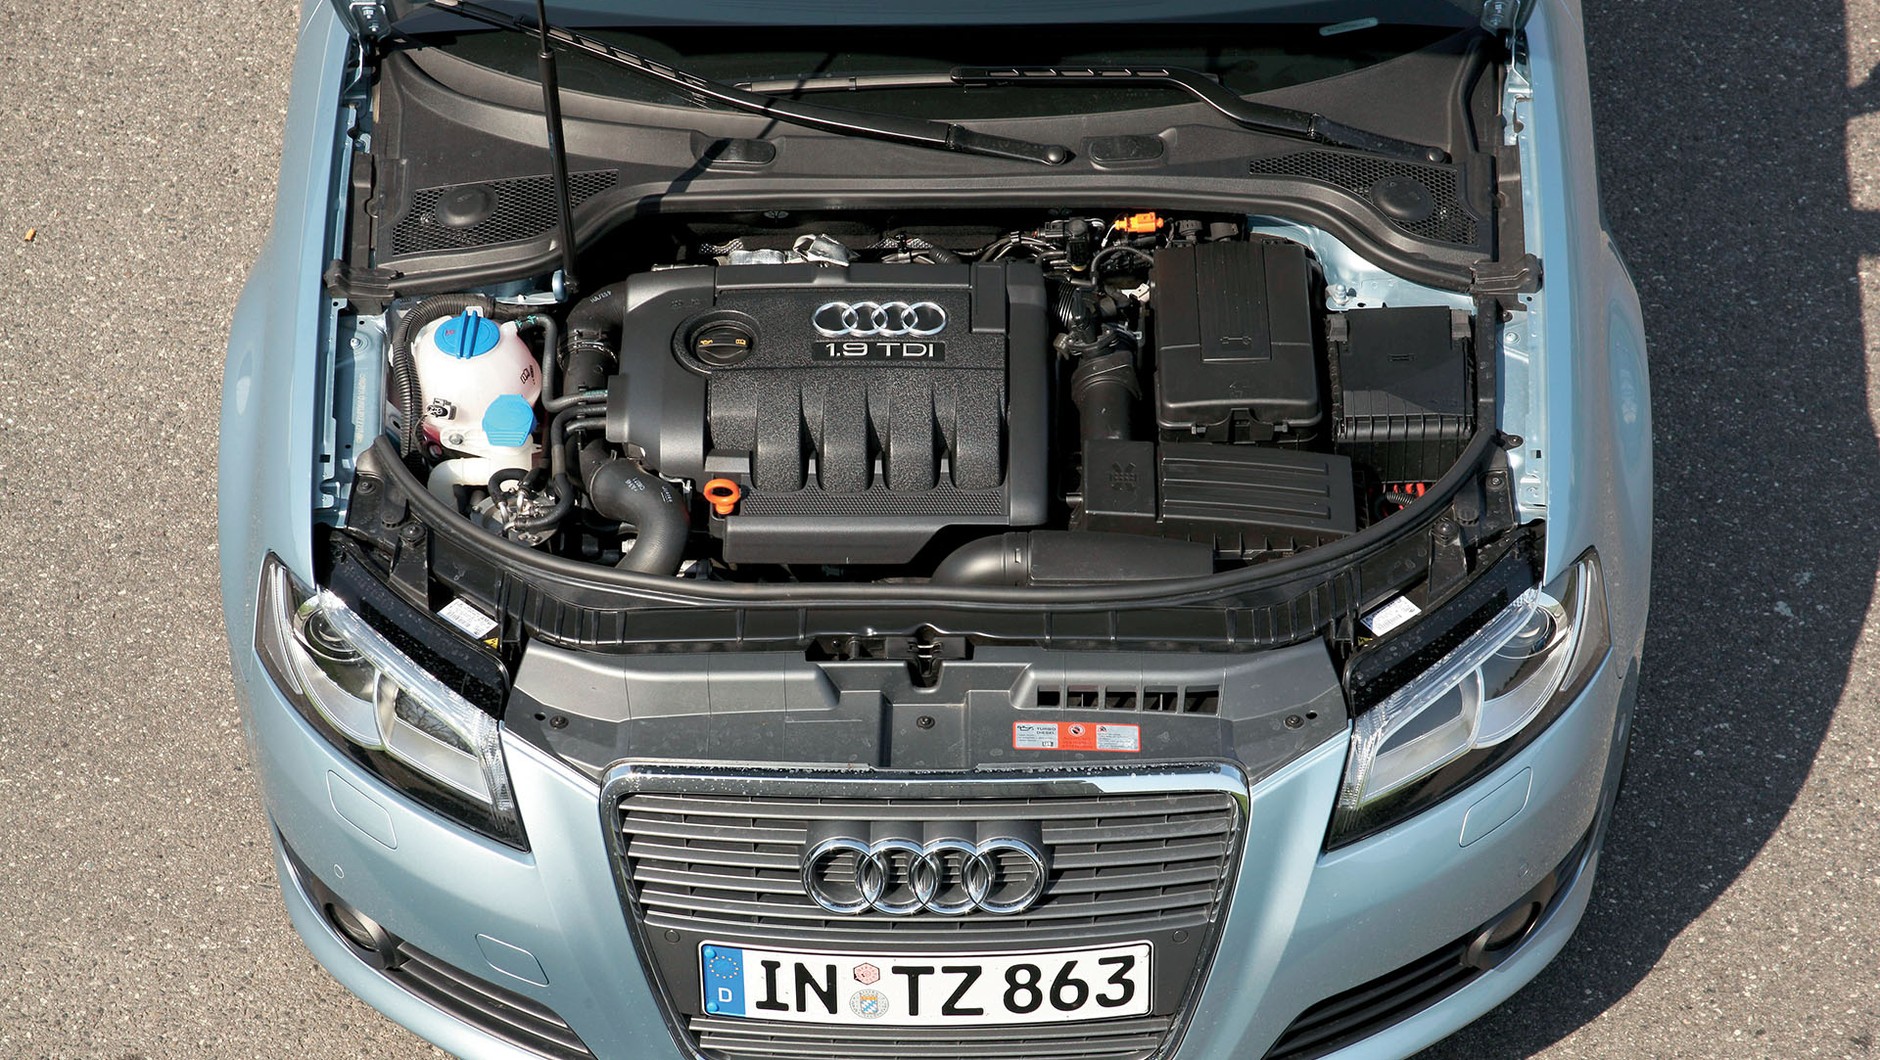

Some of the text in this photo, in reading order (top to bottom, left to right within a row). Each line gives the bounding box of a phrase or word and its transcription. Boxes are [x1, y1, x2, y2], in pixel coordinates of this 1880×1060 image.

[825, 342, 934, 358] 1.9 TDI
[755, 960, 837, 1014] IN
[891, 965, 984, 1016] TZ
[1003, 955, 1135, 1014] 863
[718, 987, 733, 1003] D
